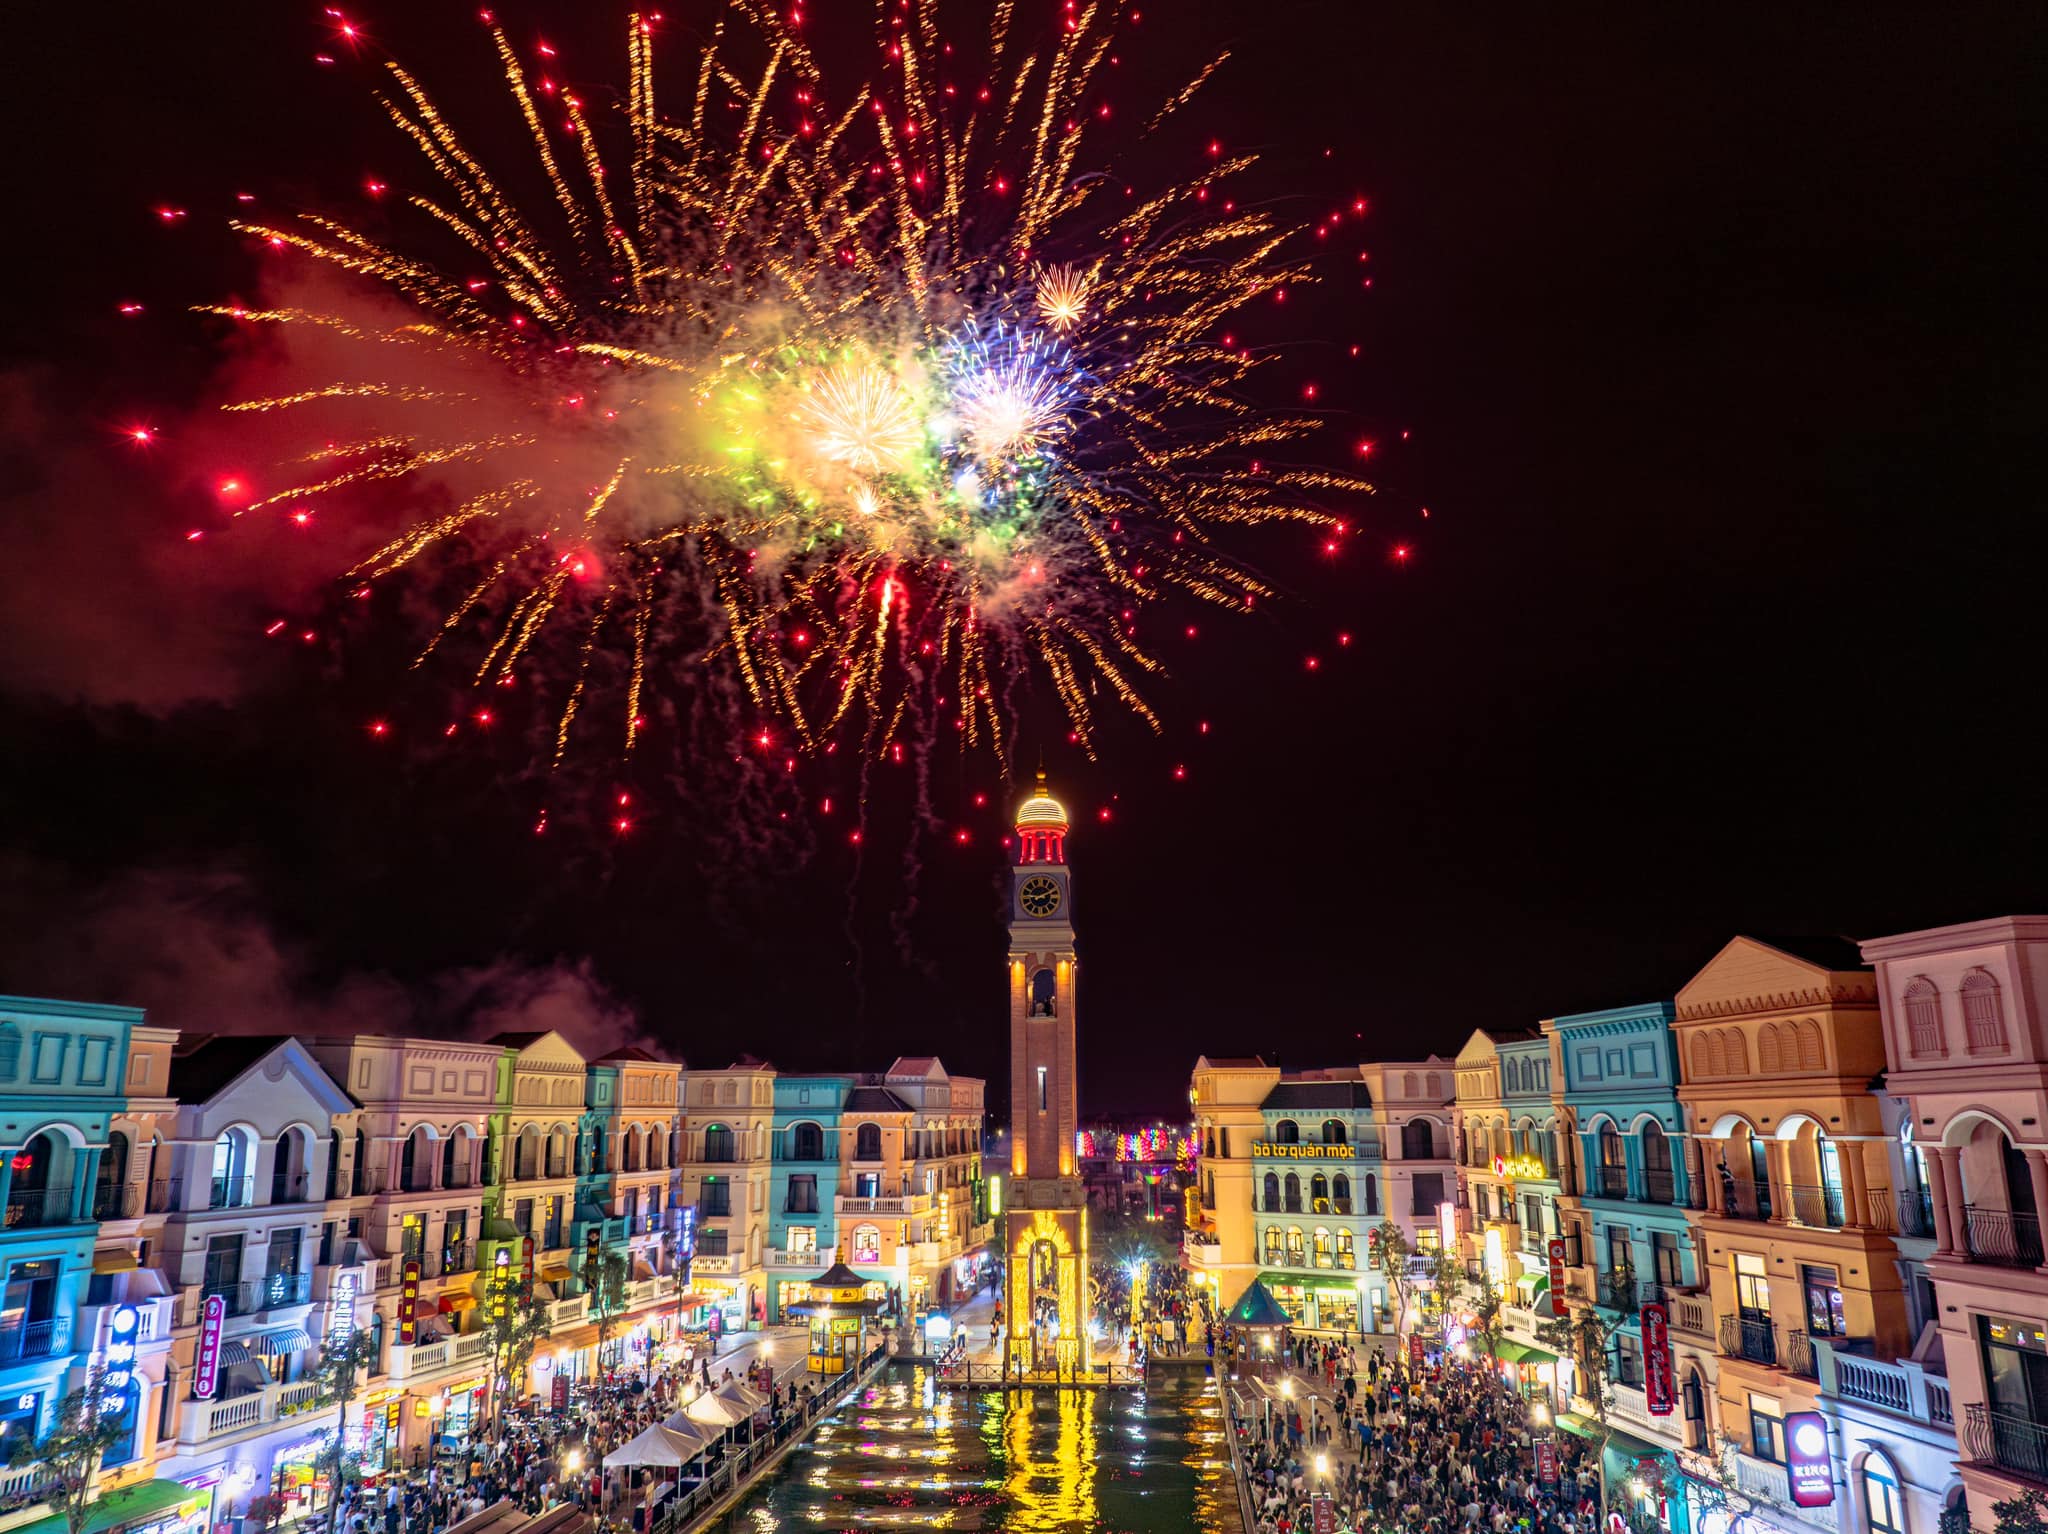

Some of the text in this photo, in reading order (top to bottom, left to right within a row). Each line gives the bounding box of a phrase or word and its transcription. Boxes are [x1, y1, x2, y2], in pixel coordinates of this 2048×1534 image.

[1289, 1142, 1324, 1160] quán
[1326, 1143, 1355, 1160] mộc
[1795, 1464, 1830, 1477] KING
